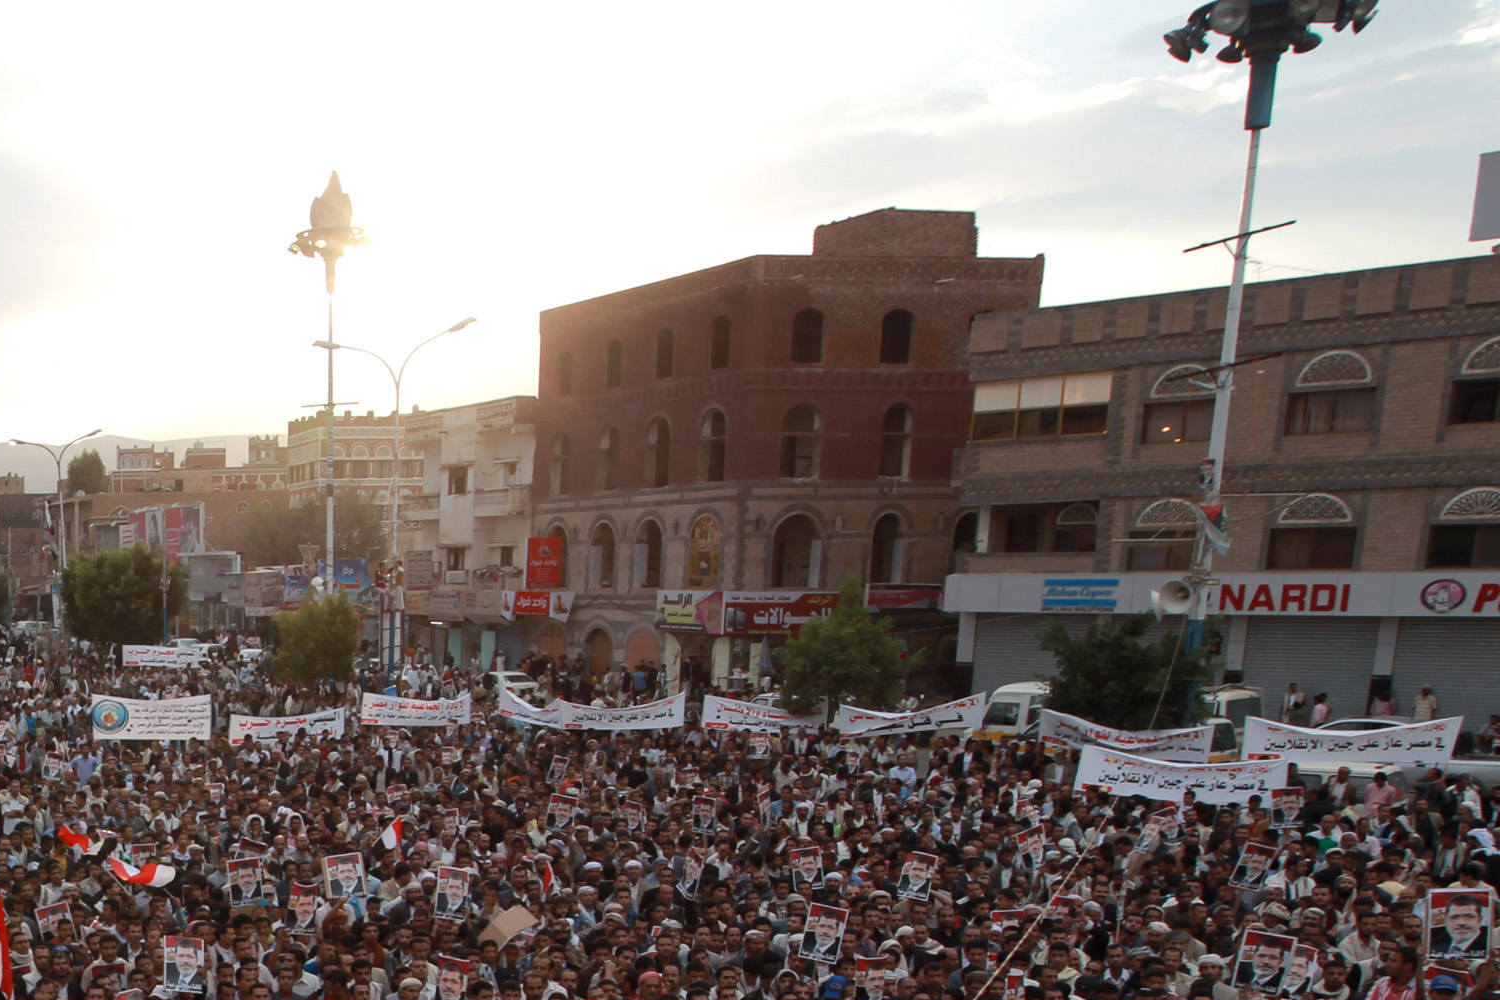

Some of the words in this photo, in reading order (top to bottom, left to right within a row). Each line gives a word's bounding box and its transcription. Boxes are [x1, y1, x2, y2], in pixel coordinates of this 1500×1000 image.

[517, 596, 532, 608] فول
[531, 597, 548, 609] واحد
[1219, 584, 1351, 612] NARDI
[1327, 738, 1355, 752] جبين
[1358, 739, 1382, 752] على
[1405, 739, 1432, 752] مصر
[1157, 772, 1183, 789] جبين
[1184, 776, 1207, 792] على
[1228, 781, 1255, 794] مصر
